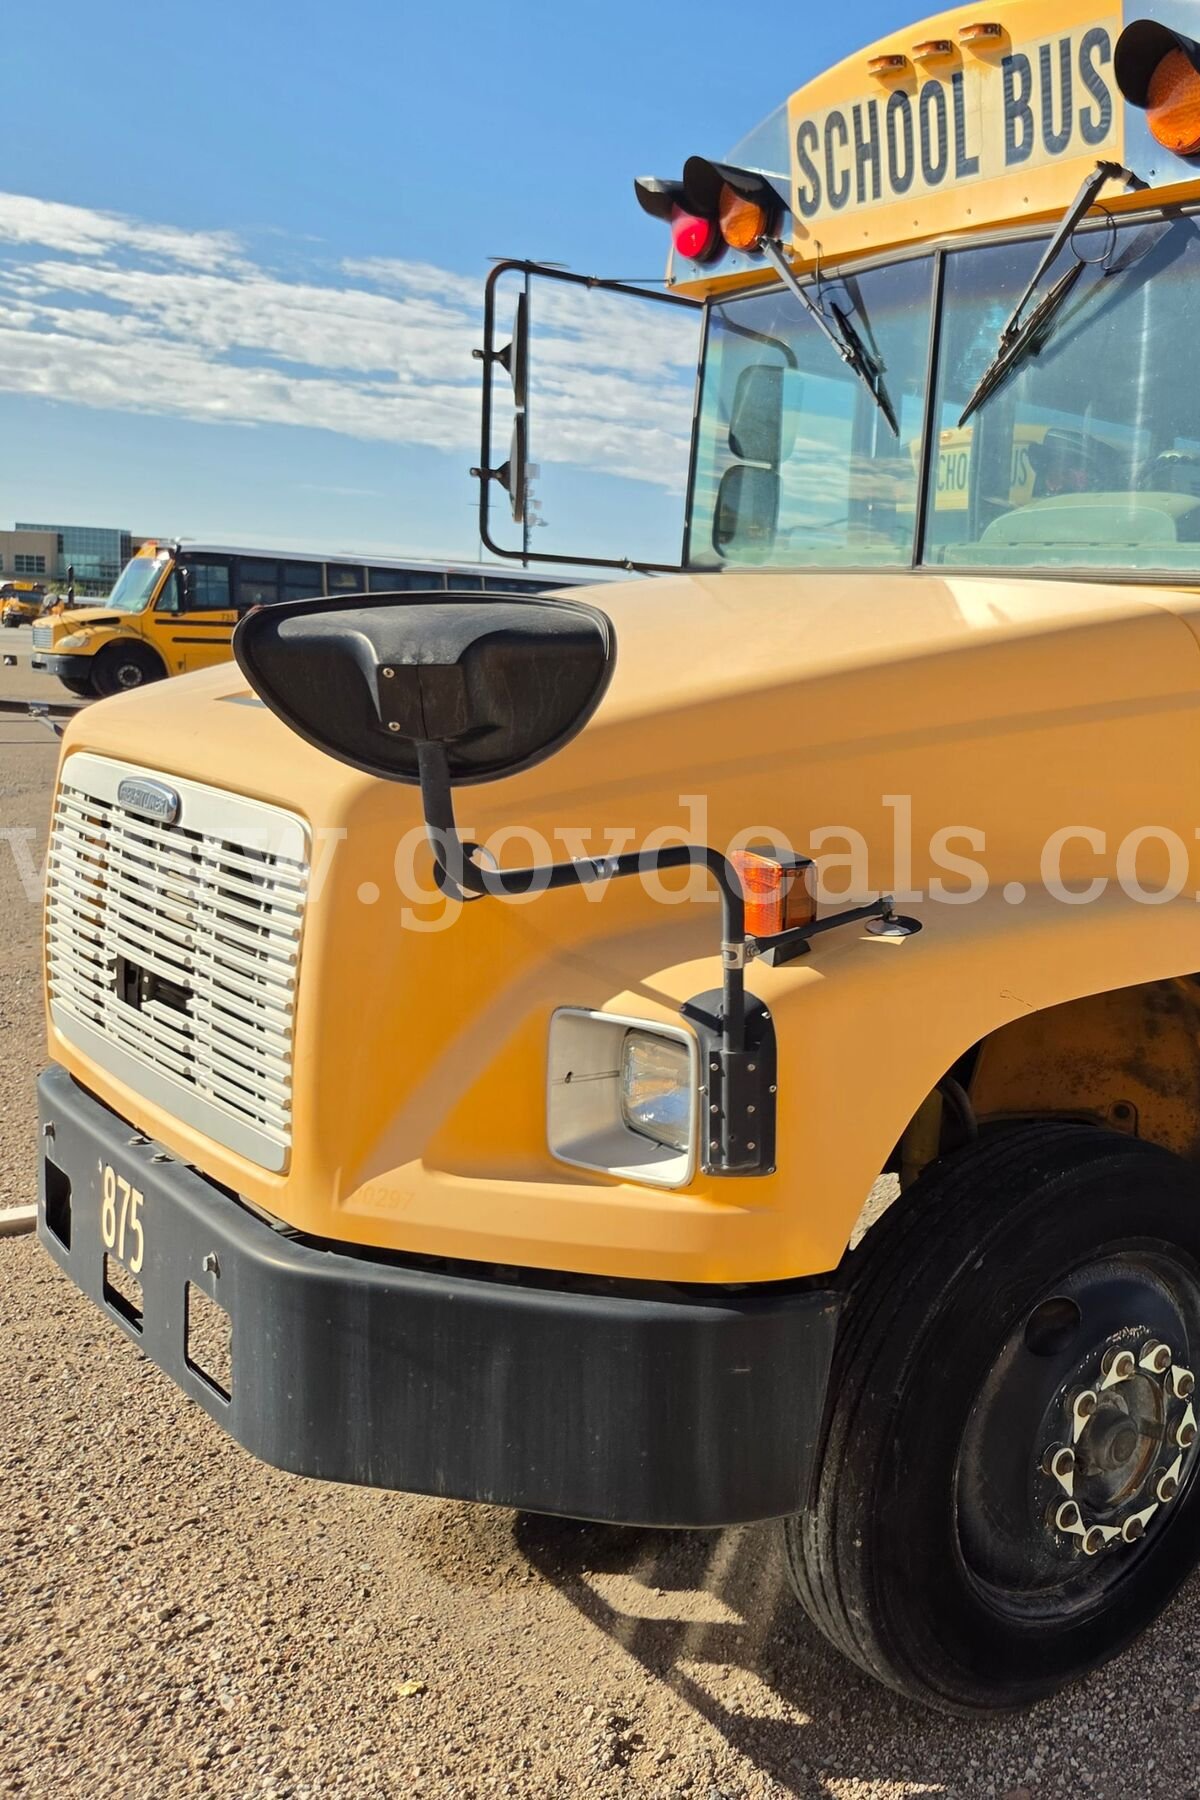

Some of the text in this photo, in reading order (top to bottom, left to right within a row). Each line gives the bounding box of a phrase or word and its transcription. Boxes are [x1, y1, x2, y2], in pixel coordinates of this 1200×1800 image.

[797, 27, 1113, 219] SCHOOL BUS
[102, 1165, 144, 1274] 875
